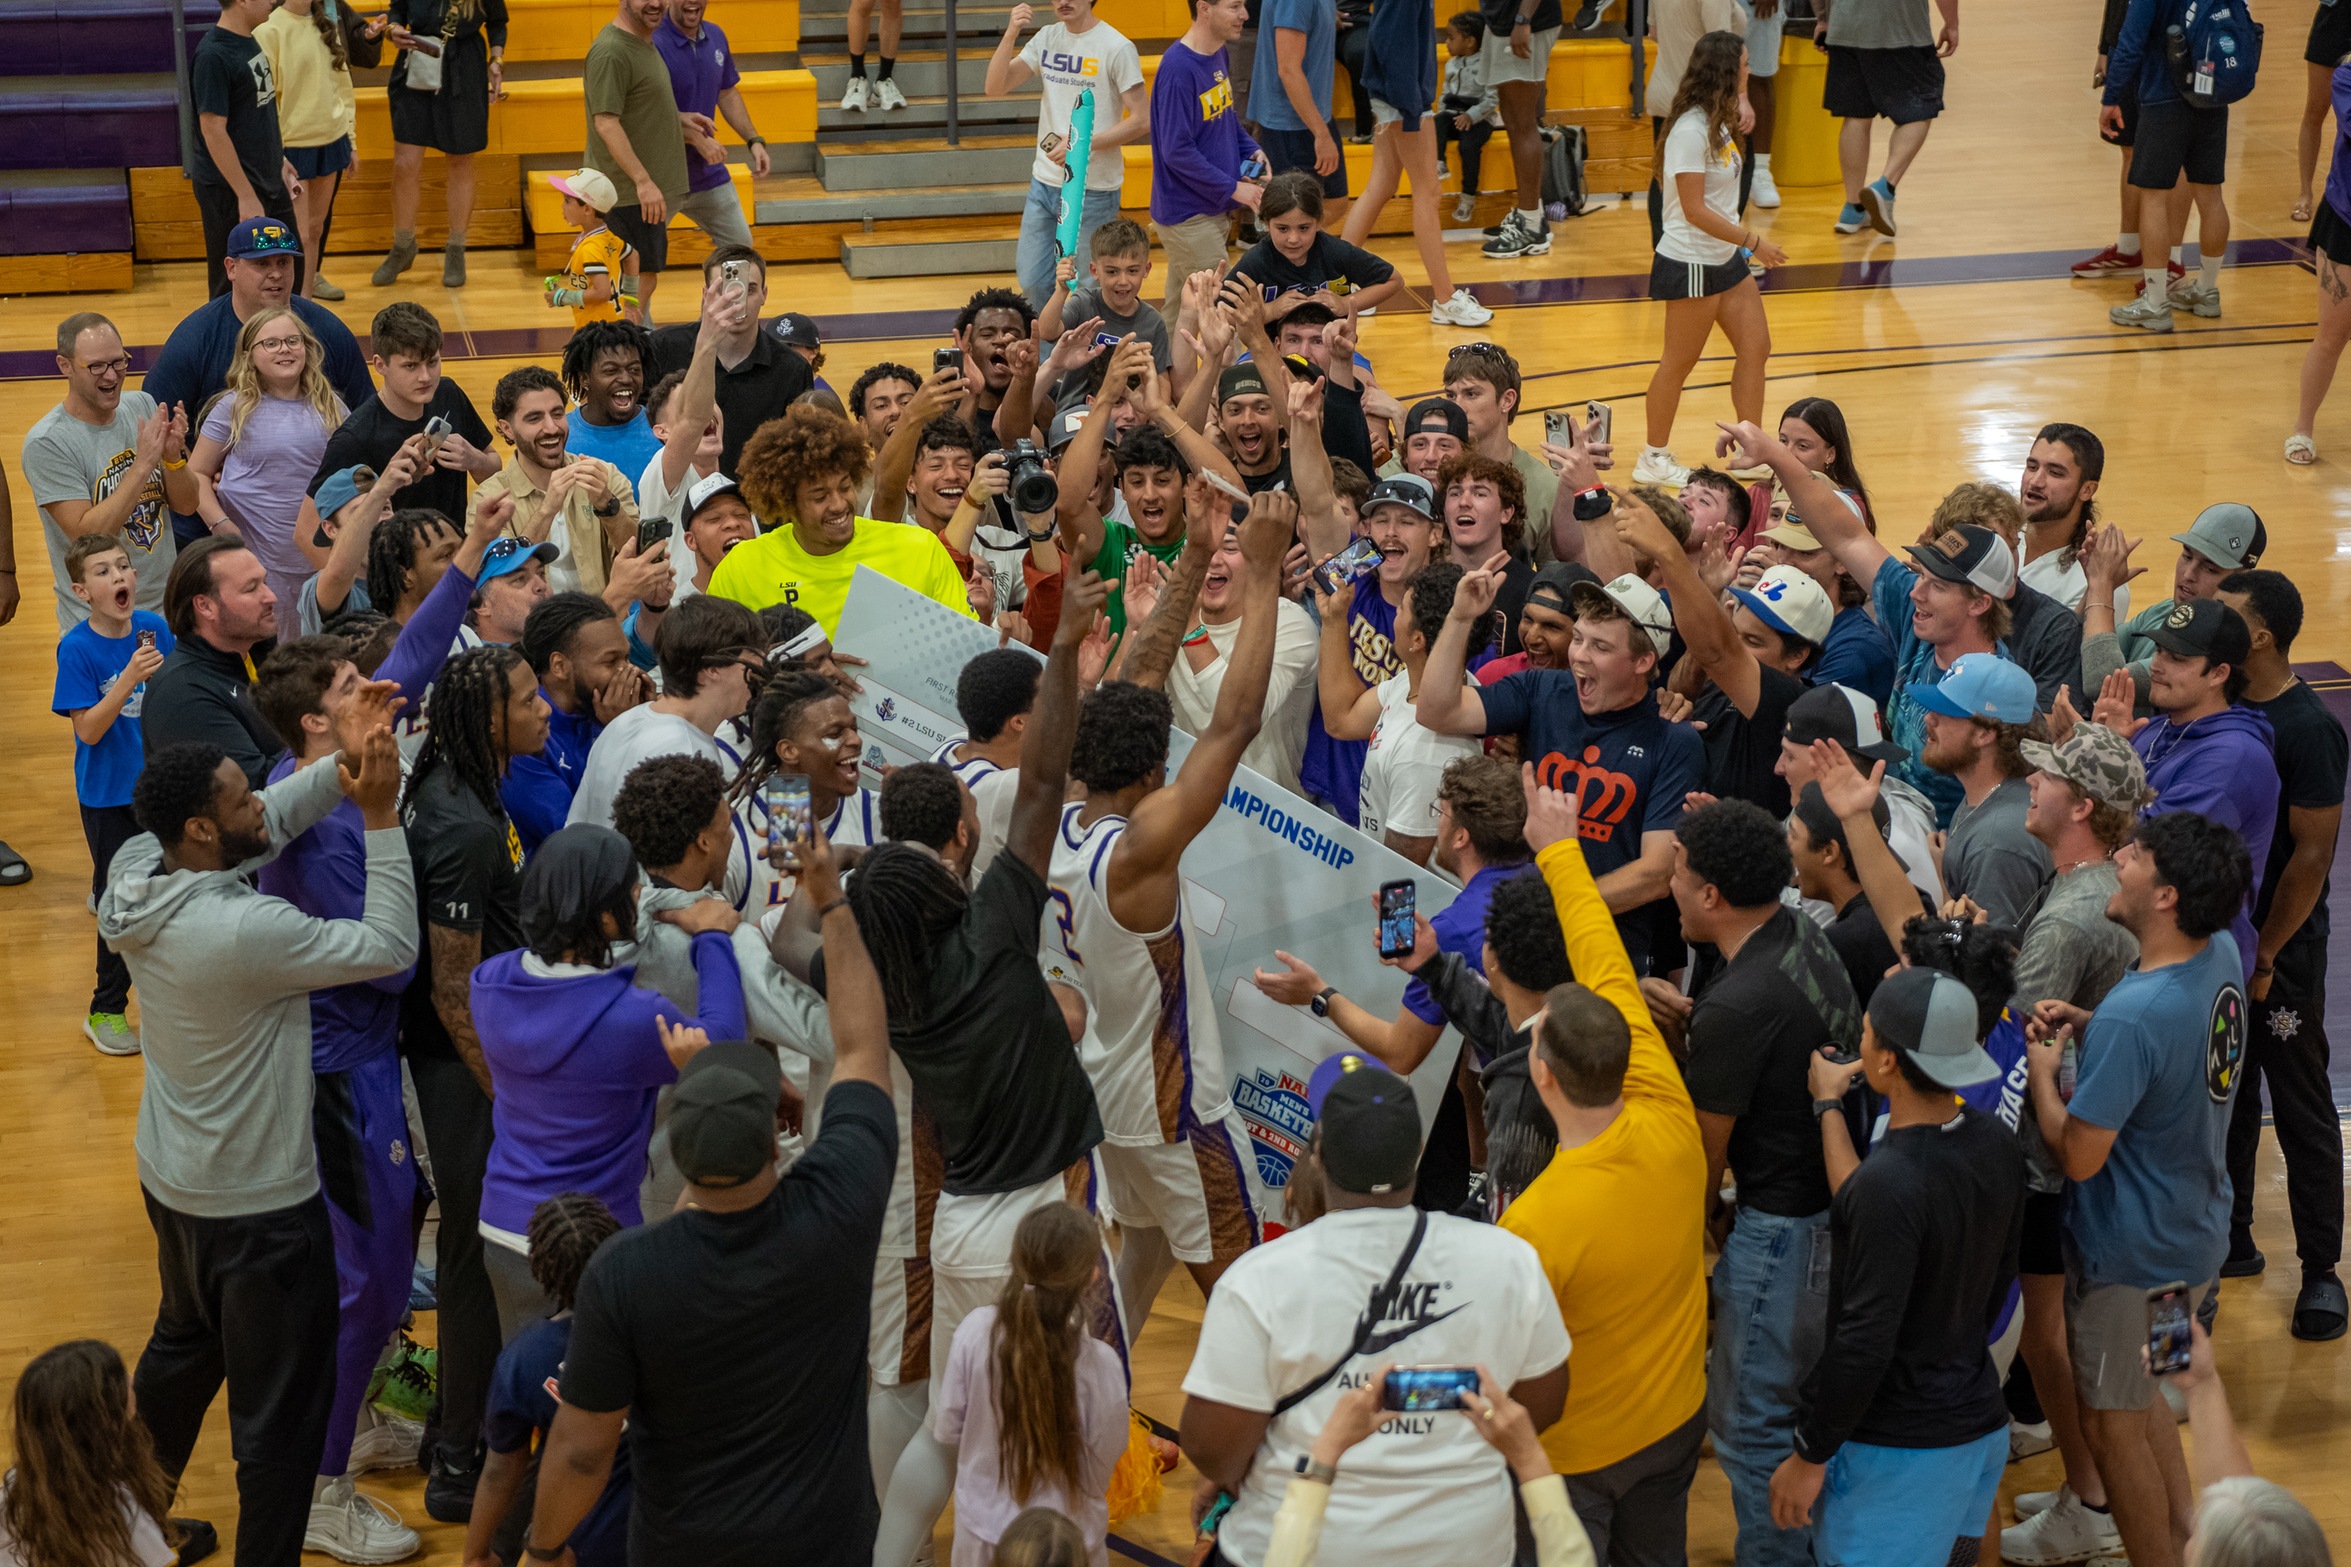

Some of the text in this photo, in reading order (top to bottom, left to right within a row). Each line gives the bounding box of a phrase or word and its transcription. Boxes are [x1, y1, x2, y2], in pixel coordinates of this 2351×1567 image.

[1041, 49, 1099, 76] LSUS
[2224, 56, 2238, 69] 18
[1043, 73, 1096, 88] raduate Studies
[925, 676, 949, 693] FIRST
[901, 717, 915, 729] #2
[915, 723, 936, 738] LSU
[446, 901, 469, 919] 11
[1235, 1081, 1315, 1138] BASKETB
[1280, 1093, 1310, 1117] MEN'S
[1259, 1128, 1268, 1138] &
[1268, 1133, 1287, 1149] 2ND
[1288, 1145, 1302, 1158] RO
[1378, 1416, 1435, 1434] ONLY
